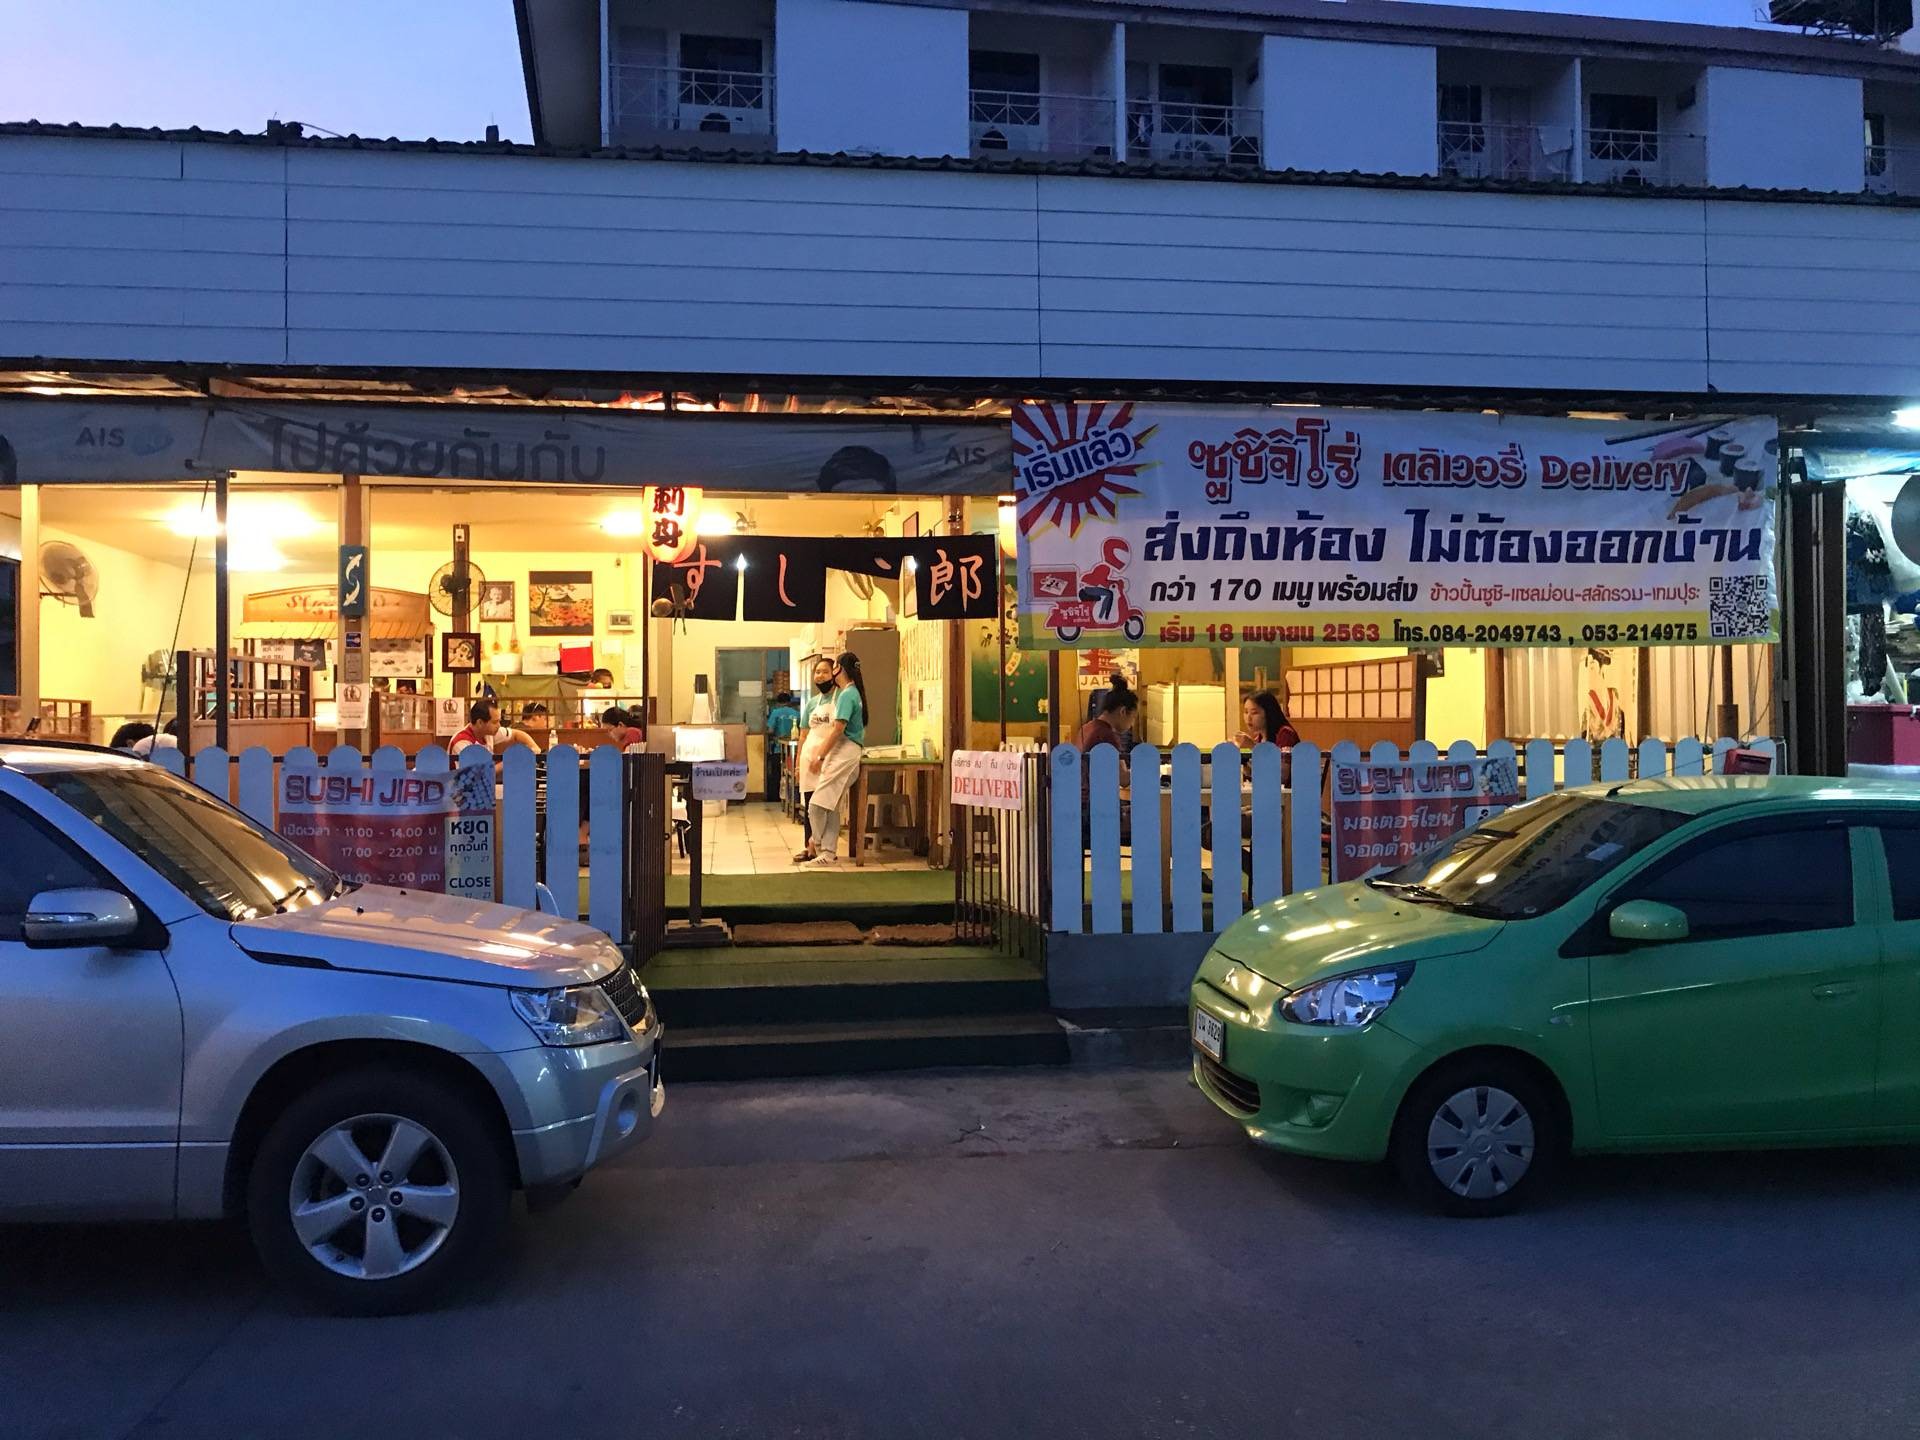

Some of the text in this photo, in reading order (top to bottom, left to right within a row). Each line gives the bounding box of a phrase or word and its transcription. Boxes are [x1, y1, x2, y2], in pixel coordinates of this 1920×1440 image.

[74, 426, 125, 448] AIS
[944, 446, 986, 465] AIS
[1022, 429, 1132, 492] เริ่มแล้ว
[1188, 417, 1690, 503] ซูชิจิโร่ เดลิเวอรี่ Delivery
[1143, 508, 1762, 564] ส่งถึงห้อง ไม่ต้องออกบ้าน
[1150, 574, 1197, 601] กว่า
[1209, 578, 1262, 601] 170
[1159, 614, 1381, 644] เริ่ม 18 เมษายน 2563
[1581, 622, 1698, 642] 053-214975
[1080, 675, 1137, 686] JAPN
[285, 774, 375, 805] SUSHI
[1337, 764, 1475, 795] SUSHI JIRO
[449, 876, 491, 889] CLOSE
